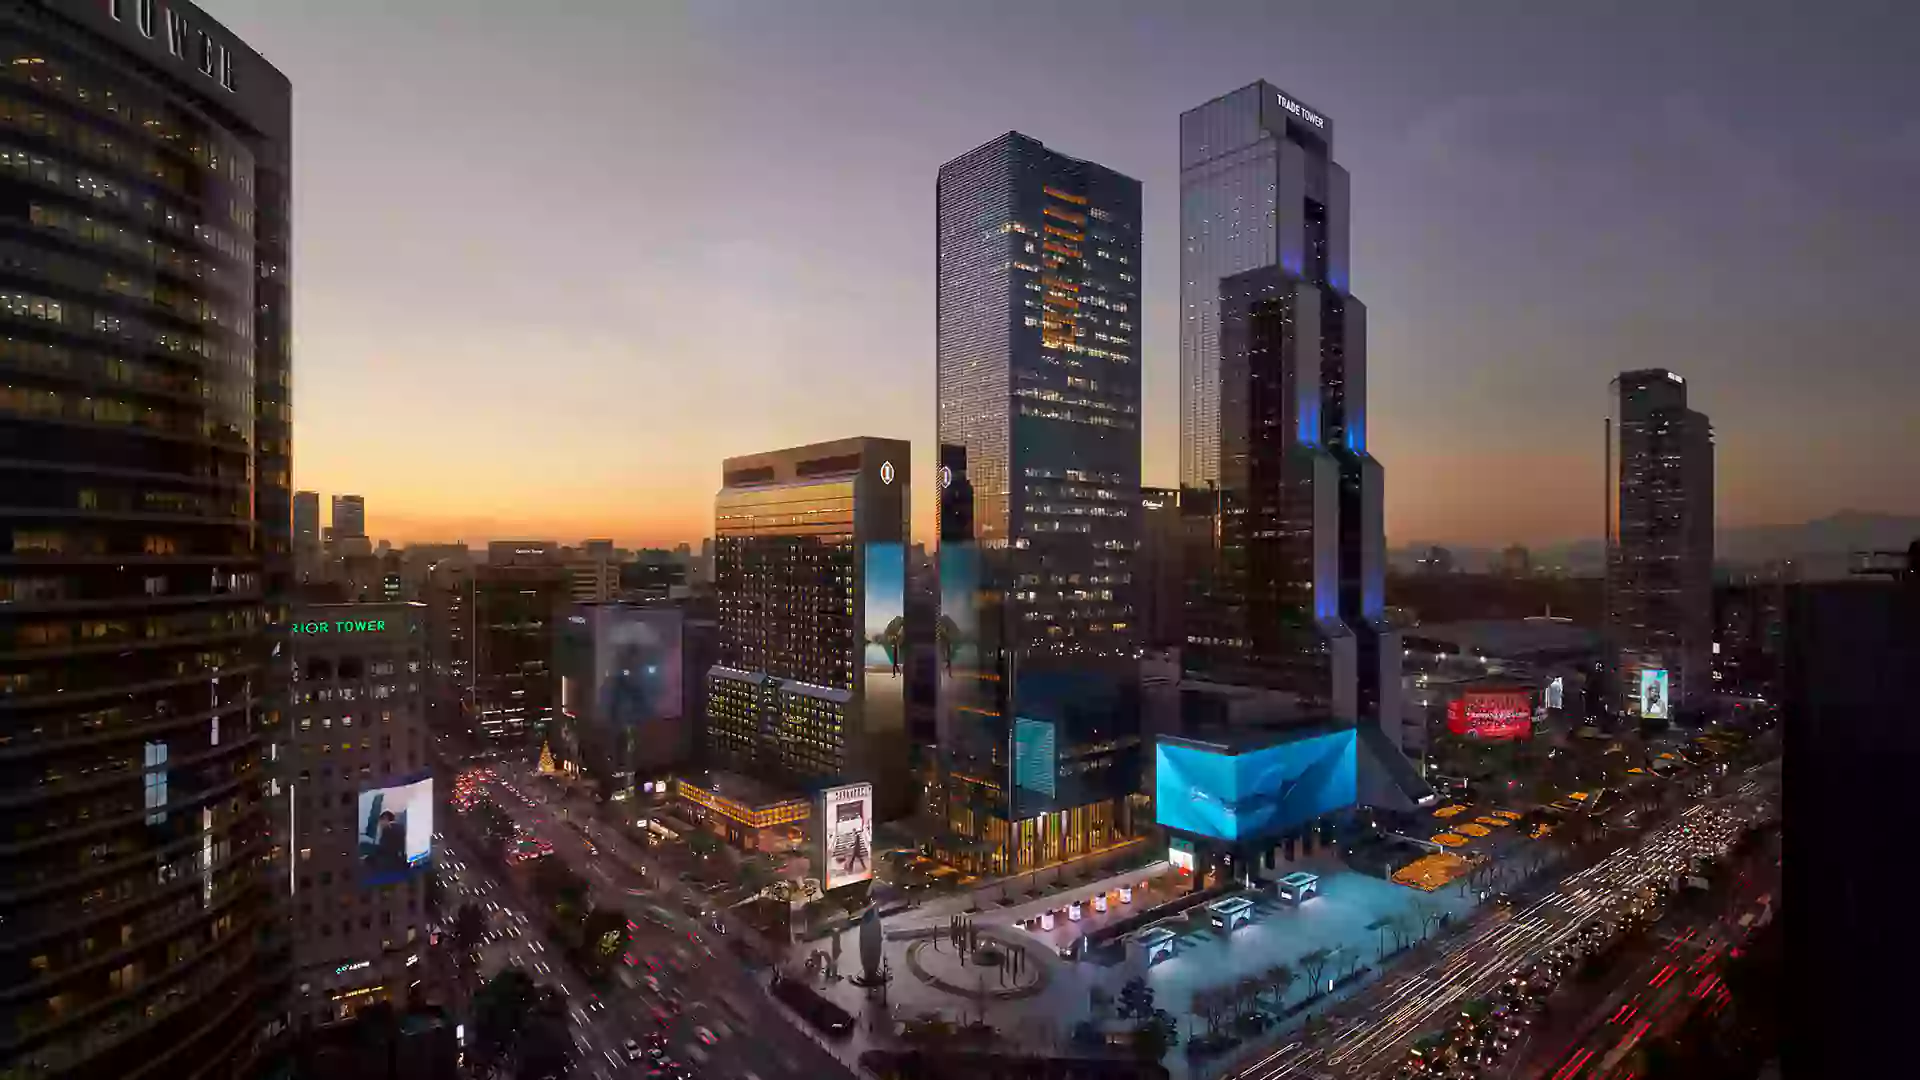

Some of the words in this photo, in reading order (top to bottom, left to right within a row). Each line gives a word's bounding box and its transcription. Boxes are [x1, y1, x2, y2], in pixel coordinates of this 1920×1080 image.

[1276, 94, 1300, 116] TRADE
[1300, 107, 1324, 129] TOWER
[335, 620, 385, 633] TOWER
